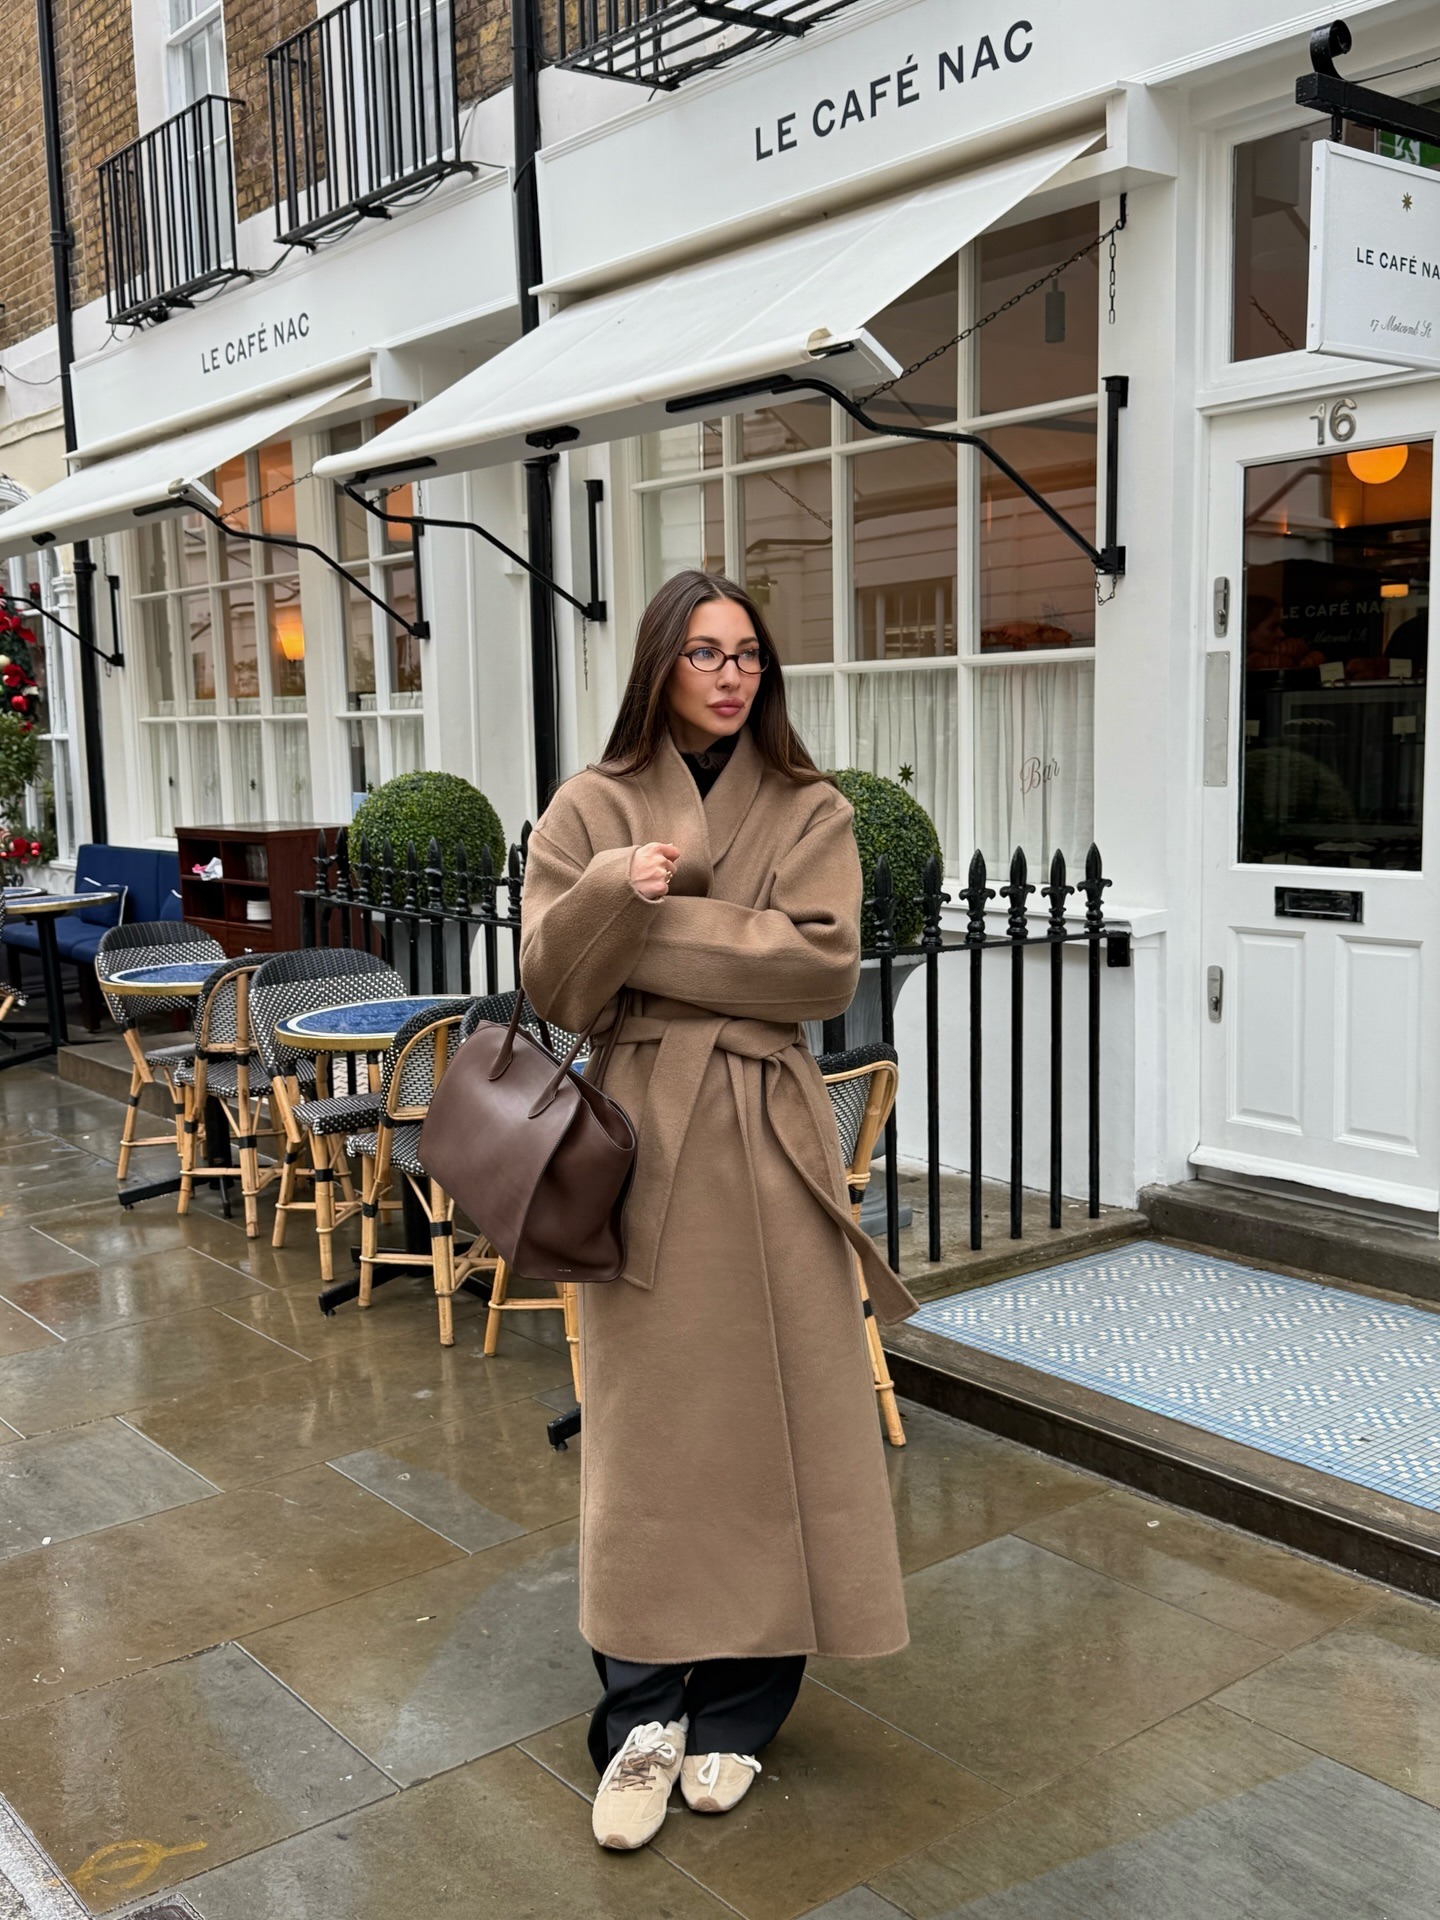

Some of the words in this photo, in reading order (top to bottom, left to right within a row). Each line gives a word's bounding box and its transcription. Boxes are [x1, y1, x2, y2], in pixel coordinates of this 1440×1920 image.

[755, 112, 798, 162] LE
[812, 53, 920, 138] CAFÉ
[938, 20, 1033, 92] NAC
[1356, 247, 1374, 266] LE
[1379, 252, 1418, 275] CAFÉ
[1422, 262, 1440, 280] NA
[201, 347, 220, 374] LE
[225, 322, 268, 365] CAFÉ
[274, 312, 310, 347] NAC
[1309, 398, 1357, 446] 16
[1280, 605, 1300, 620] LE
[1304, 599, 1351, 618] CAFÉ
[1019, 756, 1061, 796] Bar
